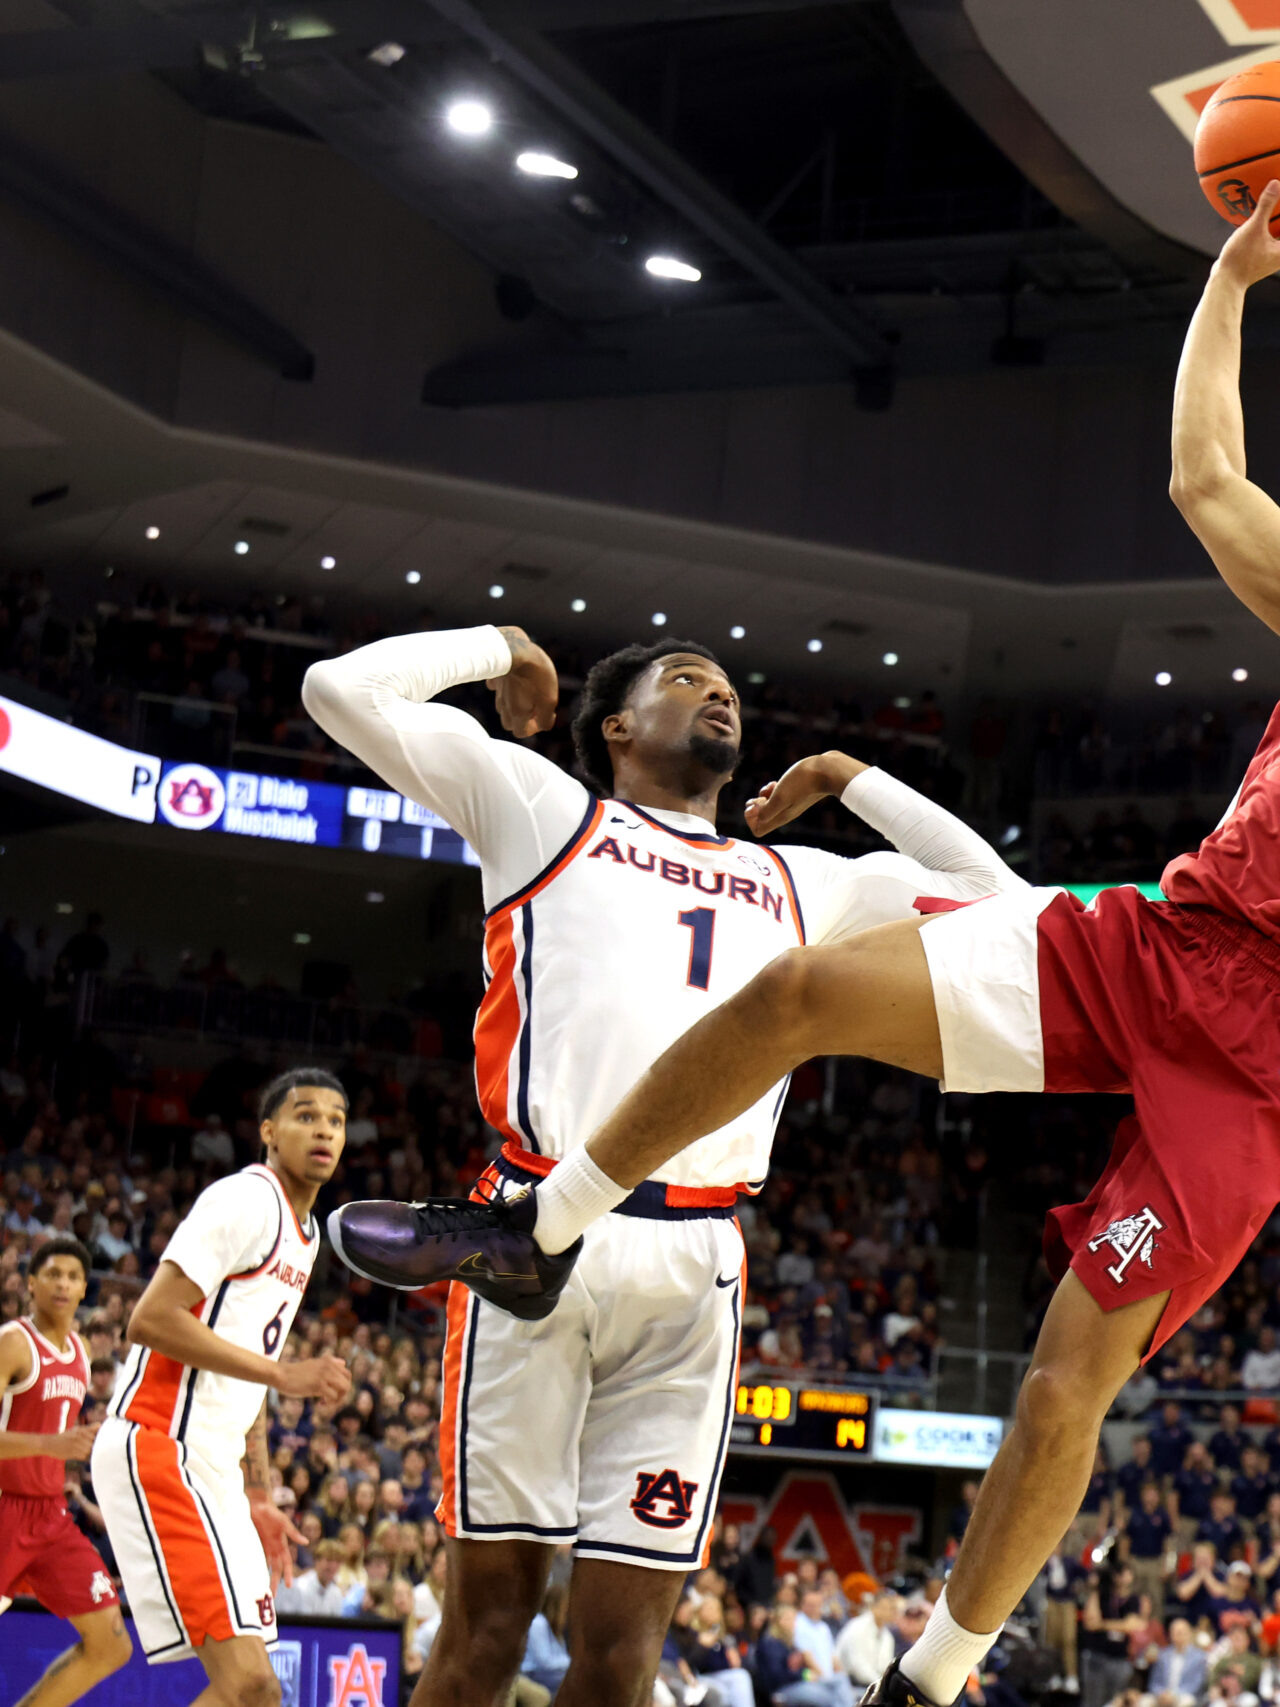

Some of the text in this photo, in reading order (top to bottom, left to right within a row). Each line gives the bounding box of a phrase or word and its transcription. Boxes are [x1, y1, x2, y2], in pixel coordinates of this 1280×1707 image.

[132, 767, 151, 797] P
[587, 834, 784, 924] AUBURN
[677, 905, 716, 992] 1
[266, 1258, 310, 1294] AUBUR
[263, 1301, 288, 1356] 6
[58, 1400, 70, 1435] 1
